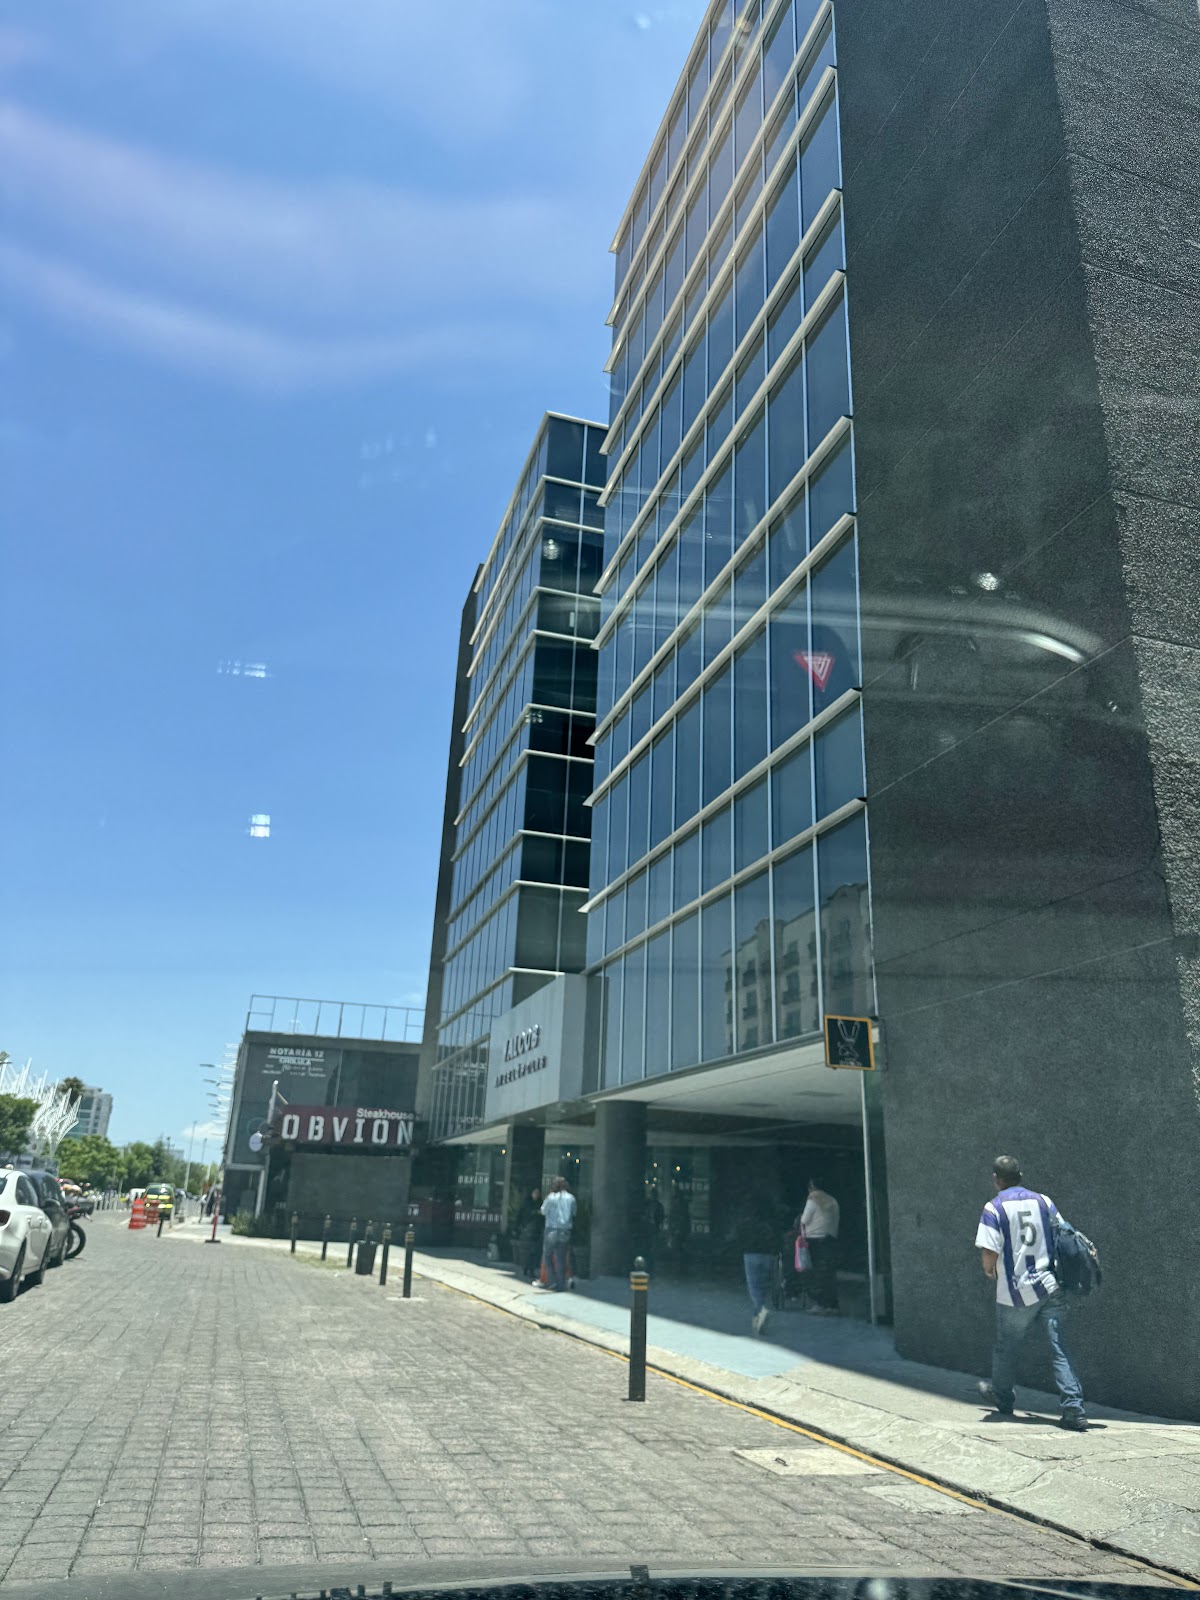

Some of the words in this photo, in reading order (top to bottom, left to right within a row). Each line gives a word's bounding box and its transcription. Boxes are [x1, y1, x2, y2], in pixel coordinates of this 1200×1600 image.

[356, 1107, 415, 1120] Steakhouse
[281, 1114, 414, 1145] OBVION
[1017, 1211, 1037, 1246] 5
